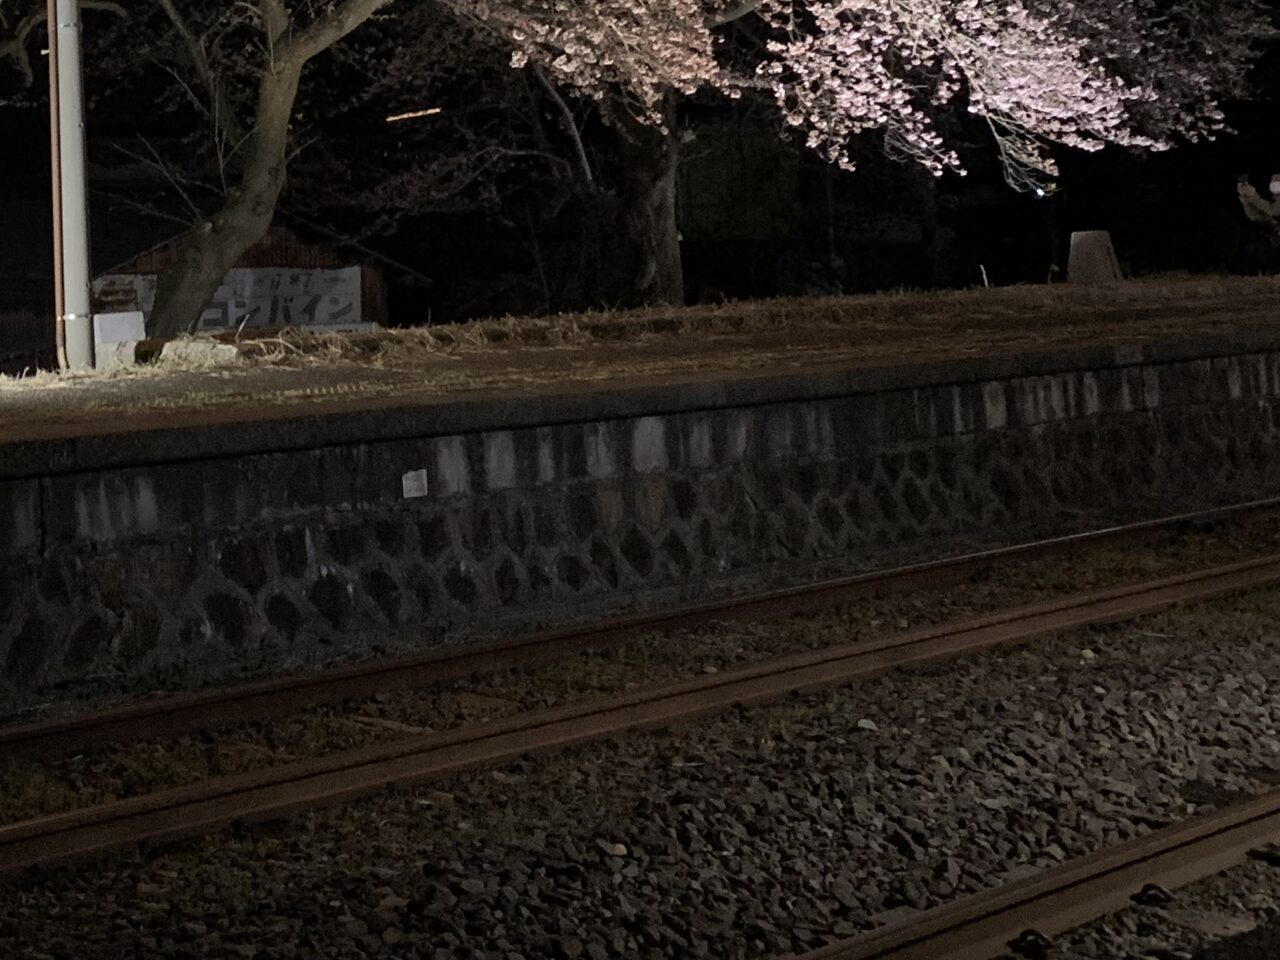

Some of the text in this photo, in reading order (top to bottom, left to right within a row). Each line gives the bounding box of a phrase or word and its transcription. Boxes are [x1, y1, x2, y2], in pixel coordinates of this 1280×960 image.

[202, 294, 354, 327] コンバイン
